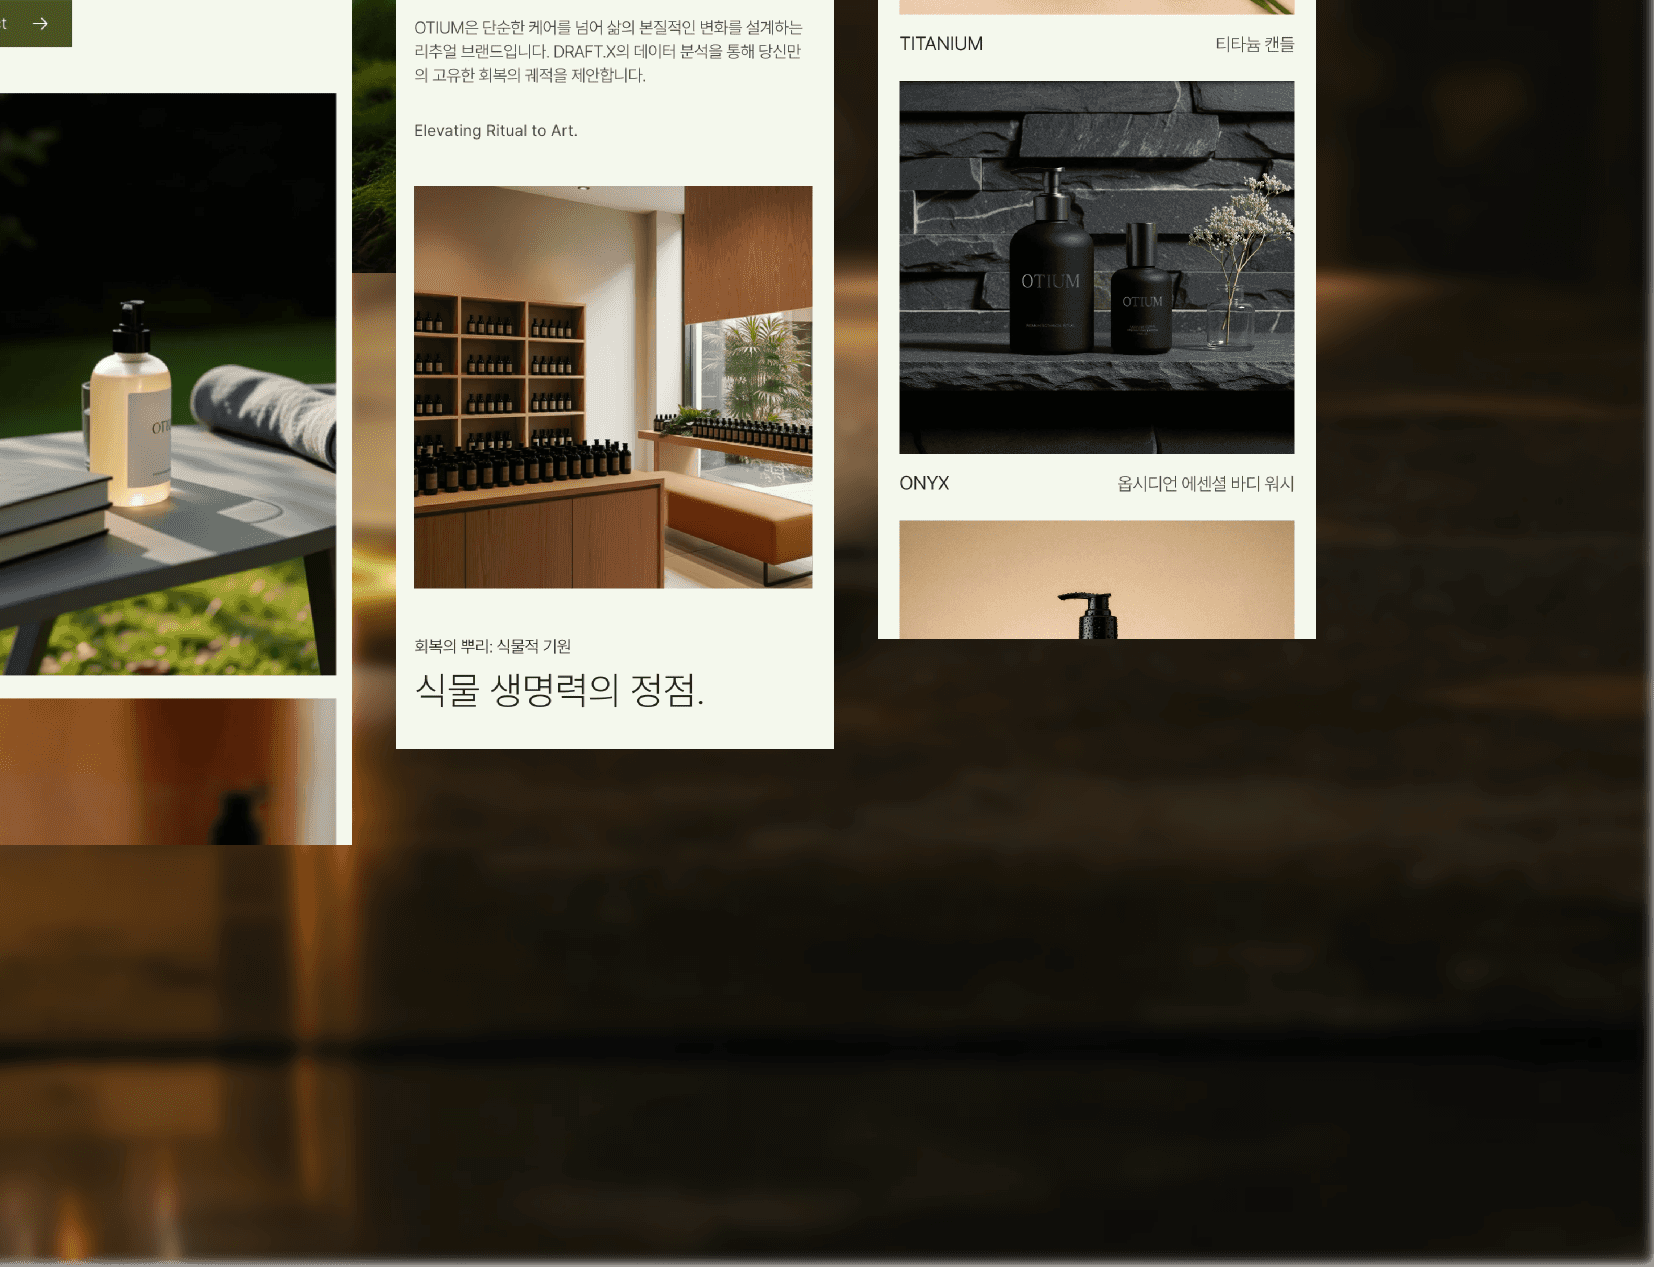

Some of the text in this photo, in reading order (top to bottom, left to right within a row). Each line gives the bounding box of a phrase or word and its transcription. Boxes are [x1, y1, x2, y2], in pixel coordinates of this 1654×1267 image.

[414, 19, 803, 36] OTIUM은 단순한 케어를 넘어 삶의 본질적인 변화를 설계하는
[415, 43, 802, 60] 리추얼 브랜드입니다. DRAFT.X의 데이터 분석을 통해 당신만
[899, 35, 983, 52] TITANIUM
[1216, 35, 1295, 53] 티타늄 캔들
[414, 66, 646, 84] 의 고유한 회복의 궤적을 제안합니다.
[414, 123, 578, 141] Elevating Ritual to Art.
[1022, 274, 1080, 288] OTIUM
[1123, 296, 1163, 307] OTIUM
[899, 475, 950, 491] ONYX
[1117, 475, 1294, 493] 옵시디언 에센셜 바디 워시
[414, 638, 571, 655] 회복의 뿌리: 식물적 기원
[415, 673, 704, 708] 식물 생명력의 정점.
